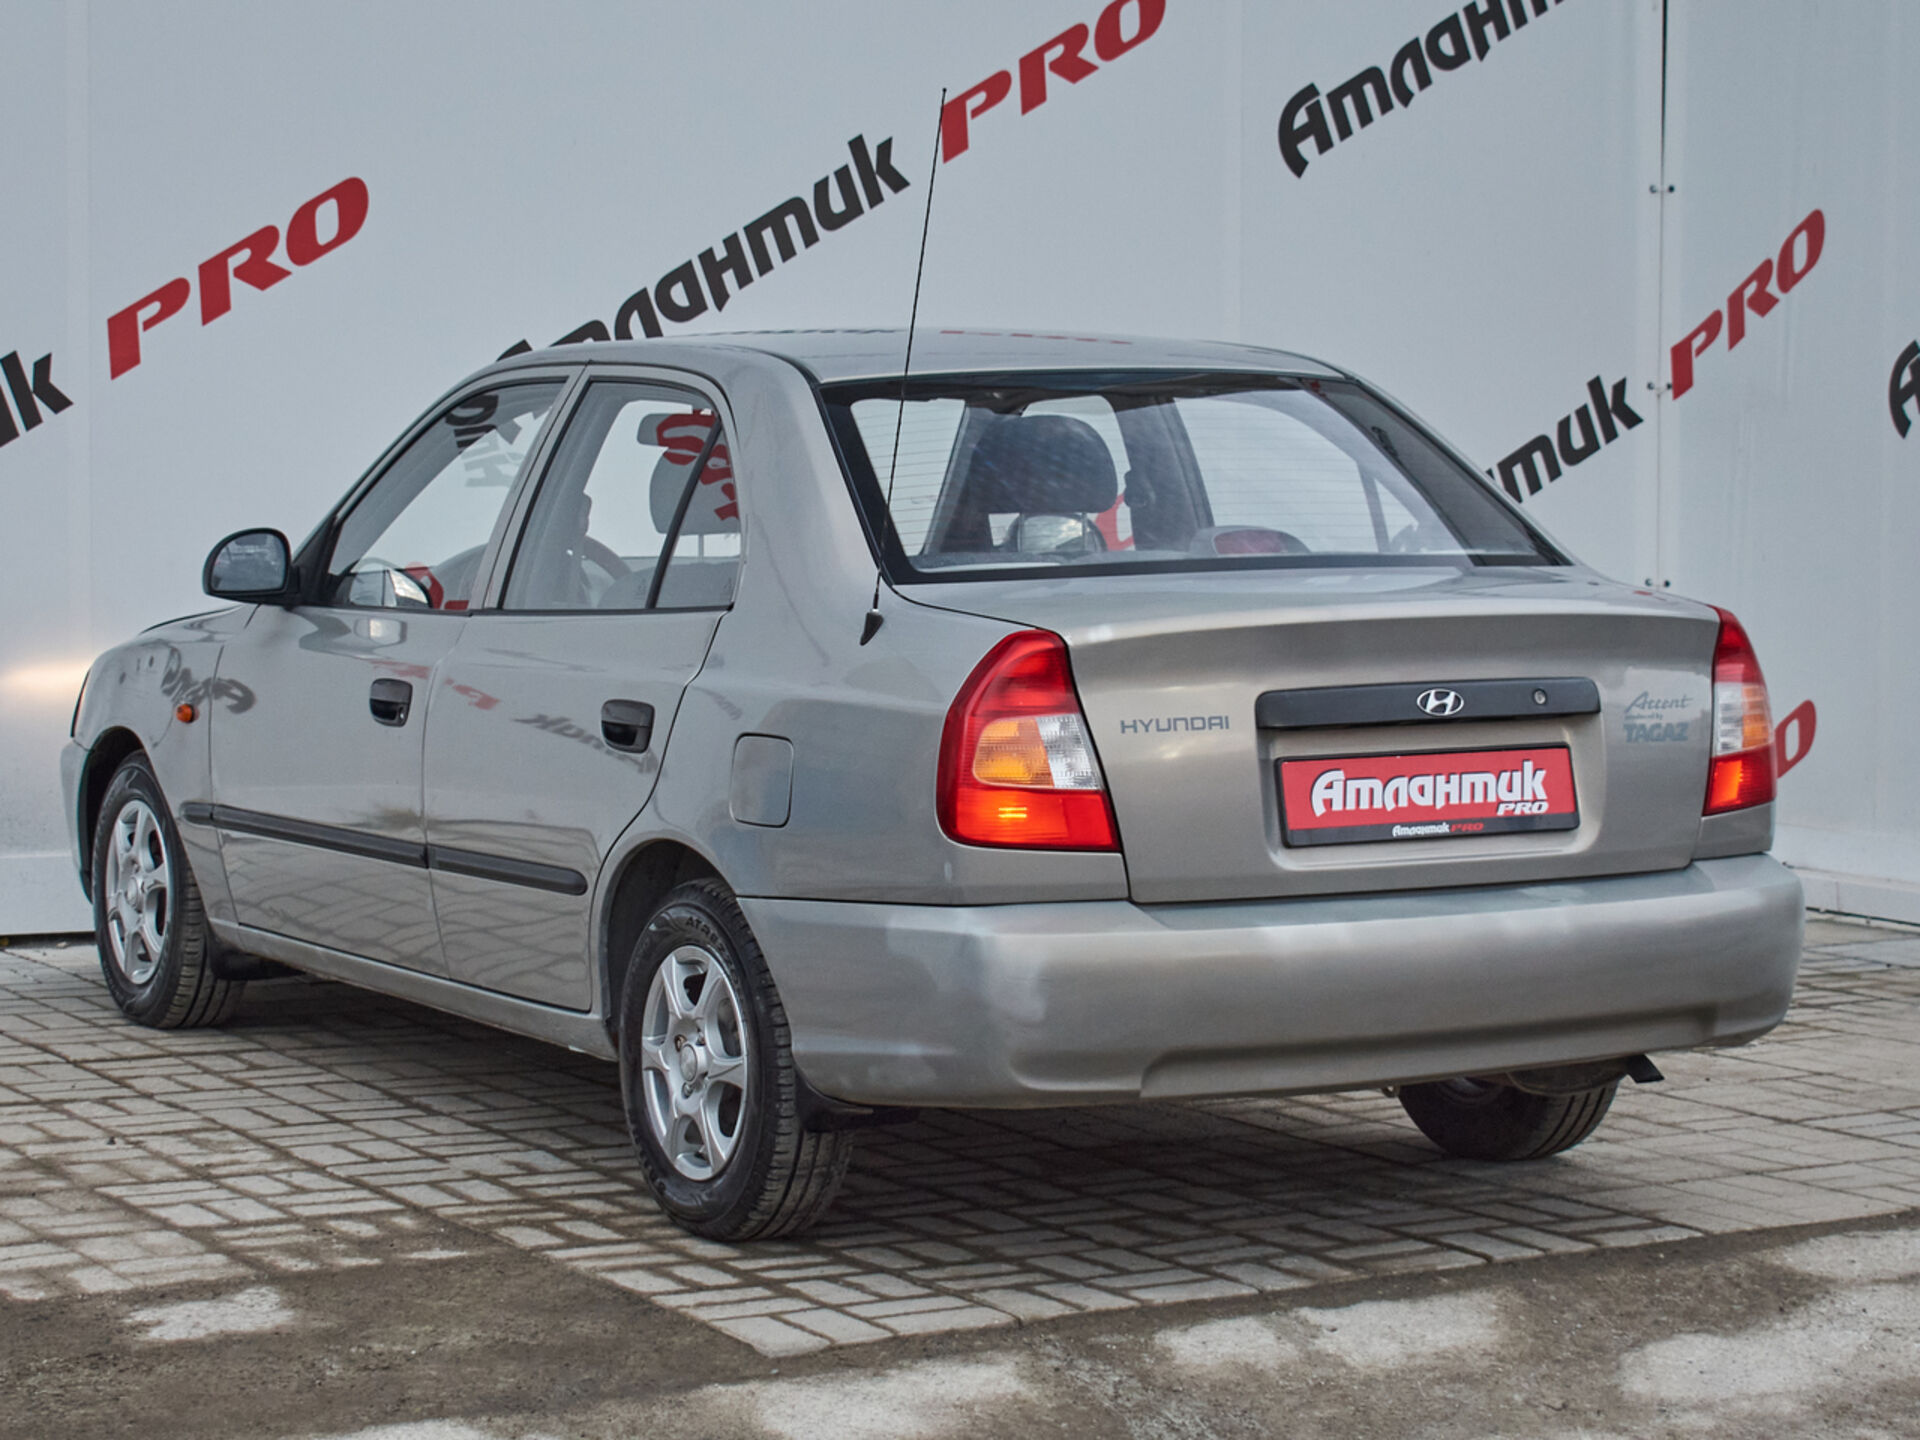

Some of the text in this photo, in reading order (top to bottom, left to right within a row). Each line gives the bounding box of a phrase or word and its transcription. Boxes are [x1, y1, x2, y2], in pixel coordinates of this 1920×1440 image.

[496, 0, 1166, 360] лантик PRO
[107, 177, 369, 380] PRO
[1670, 209, 1825, 400] PRO
[1624, 691, 1694, 714] Accent
[1120, 715, 1230, 734] HYUNDAI
[1623, 722, 1689, 743] TAGAZ
[1497, 801, 1549, 816] PRO
[1450, 822, 1484, 832] PRO
